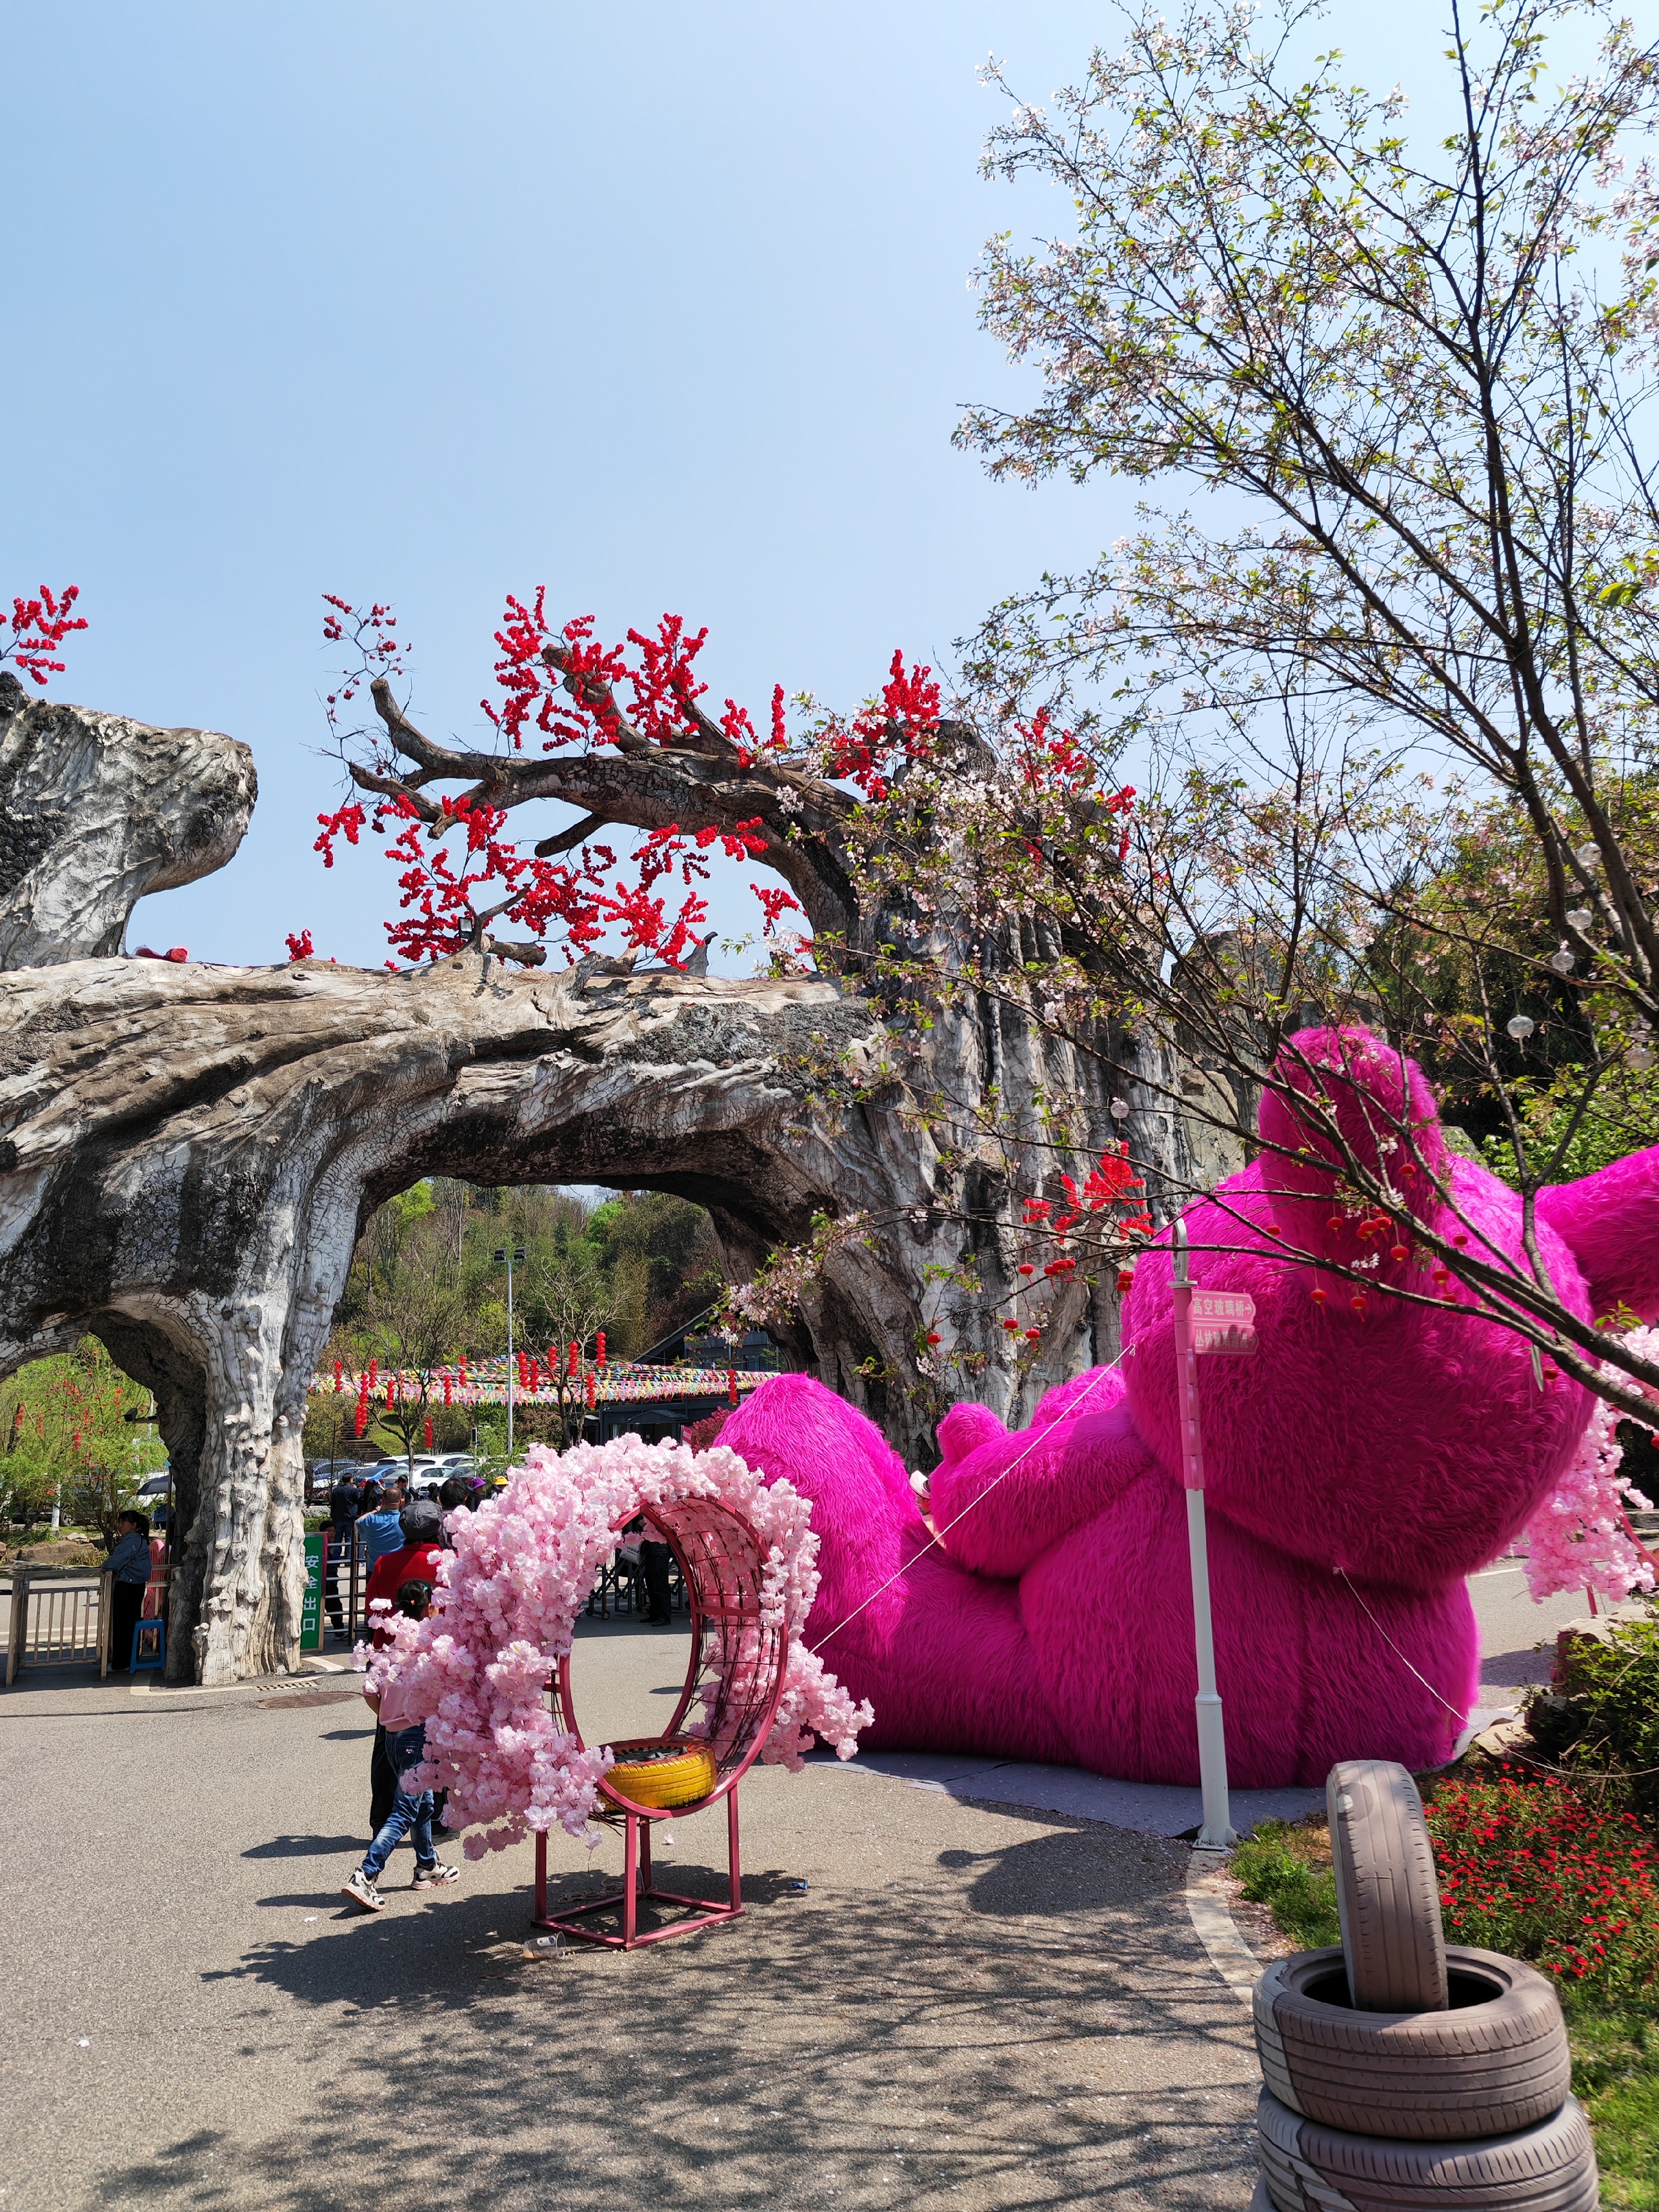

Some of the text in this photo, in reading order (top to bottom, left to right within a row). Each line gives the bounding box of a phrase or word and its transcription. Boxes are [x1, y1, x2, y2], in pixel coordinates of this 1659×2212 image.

[1193, 1297, 1244, 1317] 高空玻璃桥
[1195, 1329, 1248, 1349] 丛林玻璃漂流
[303, 1555, 319, 1631] 安全出口
